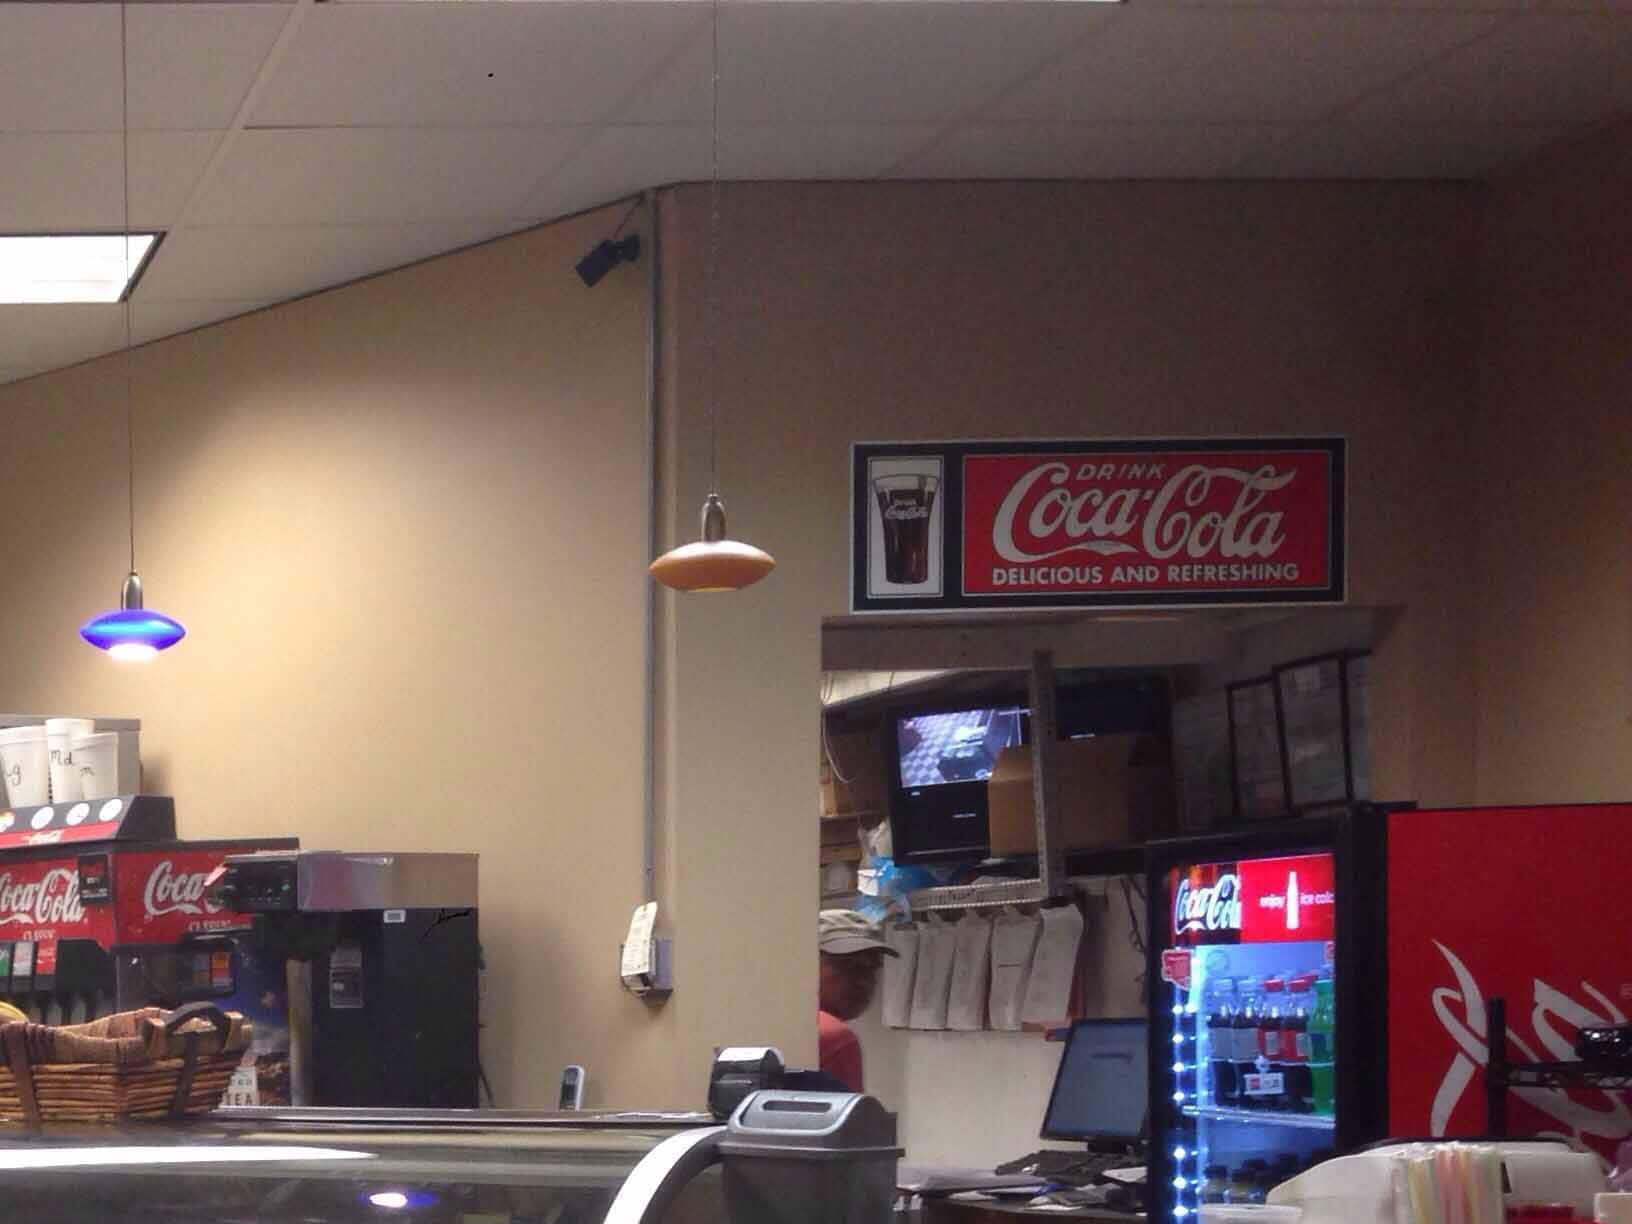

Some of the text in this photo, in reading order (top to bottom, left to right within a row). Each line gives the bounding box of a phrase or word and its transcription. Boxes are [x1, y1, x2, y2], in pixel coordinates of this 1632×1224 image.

[1076, 463, 1167, 481] DRINK
[992, 562, 1299, 585] DELICIOUS AND REFRESHING
